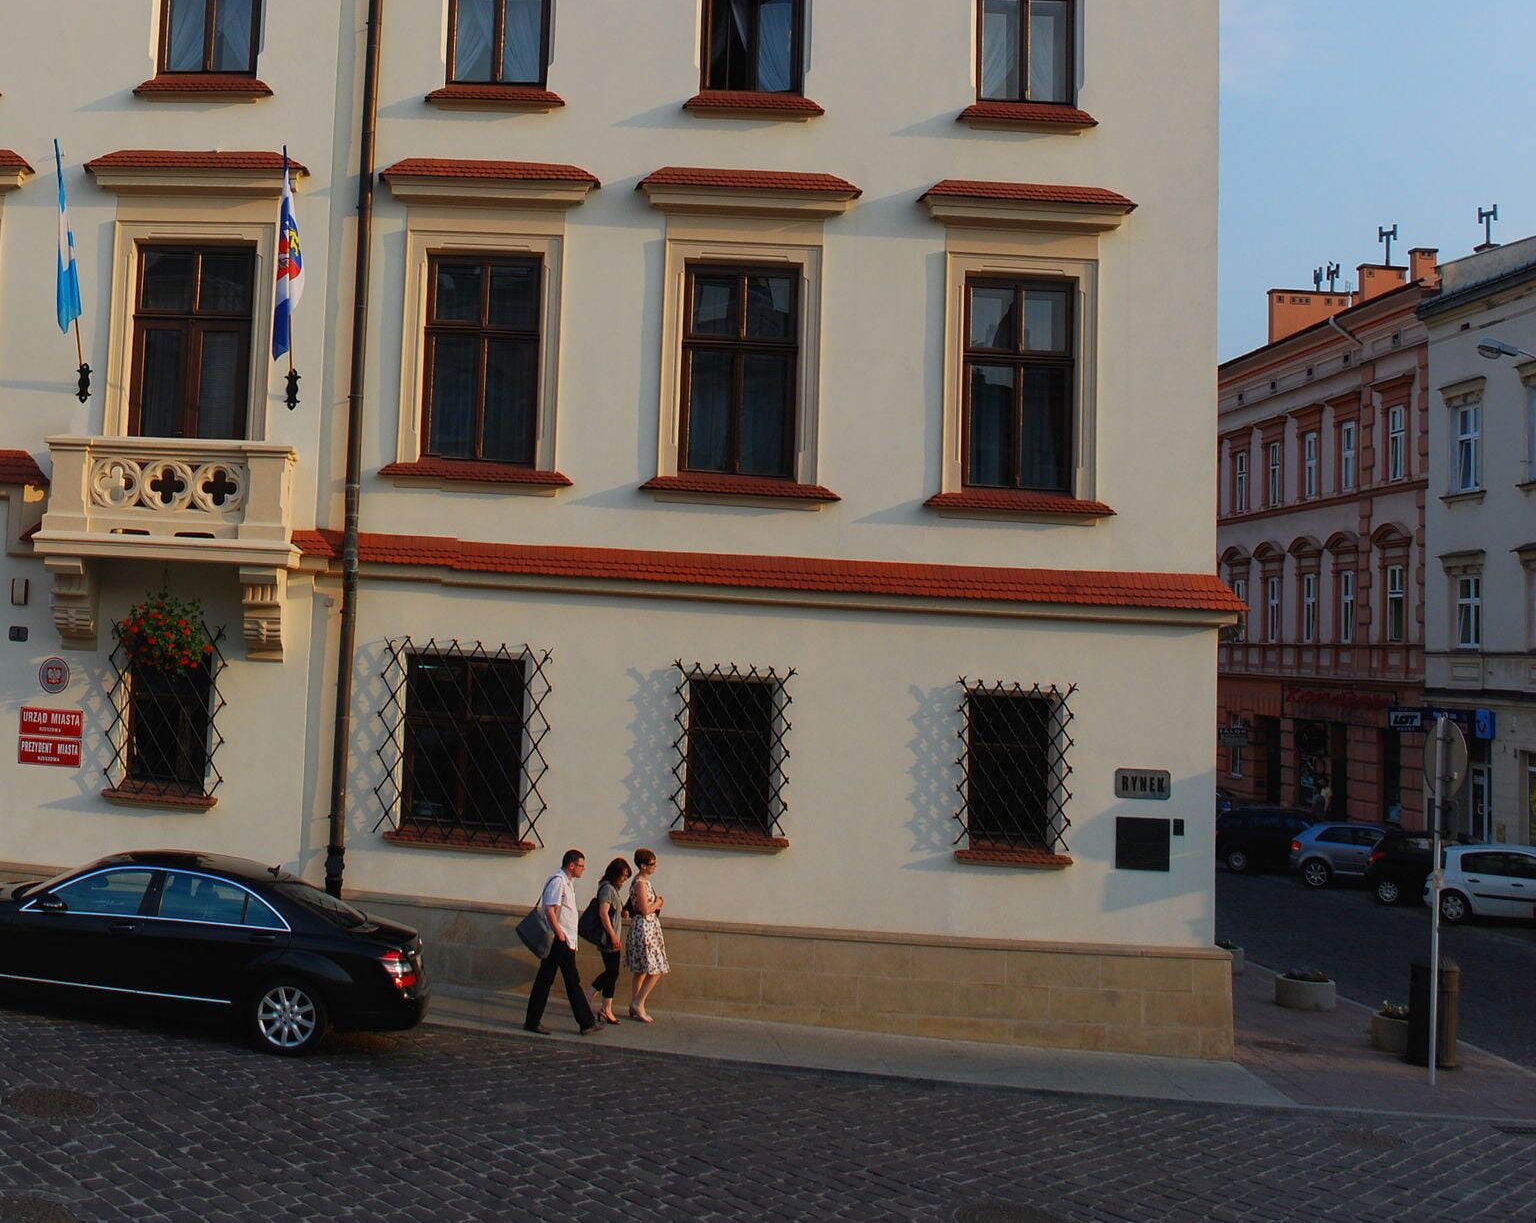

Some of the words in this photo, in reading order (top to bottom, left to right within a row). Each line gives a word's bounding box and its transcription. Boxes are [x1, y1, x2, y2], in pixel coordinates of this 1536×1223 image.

[23, 712, 48, 724] URZĄD
[51, 713, 80, 726] MIASTA
[21, 741, 52, 754] PREZYDENT
[57, 743, 78, 756] MIASTA
[1122, 776, 1165, 793] RYNEK
